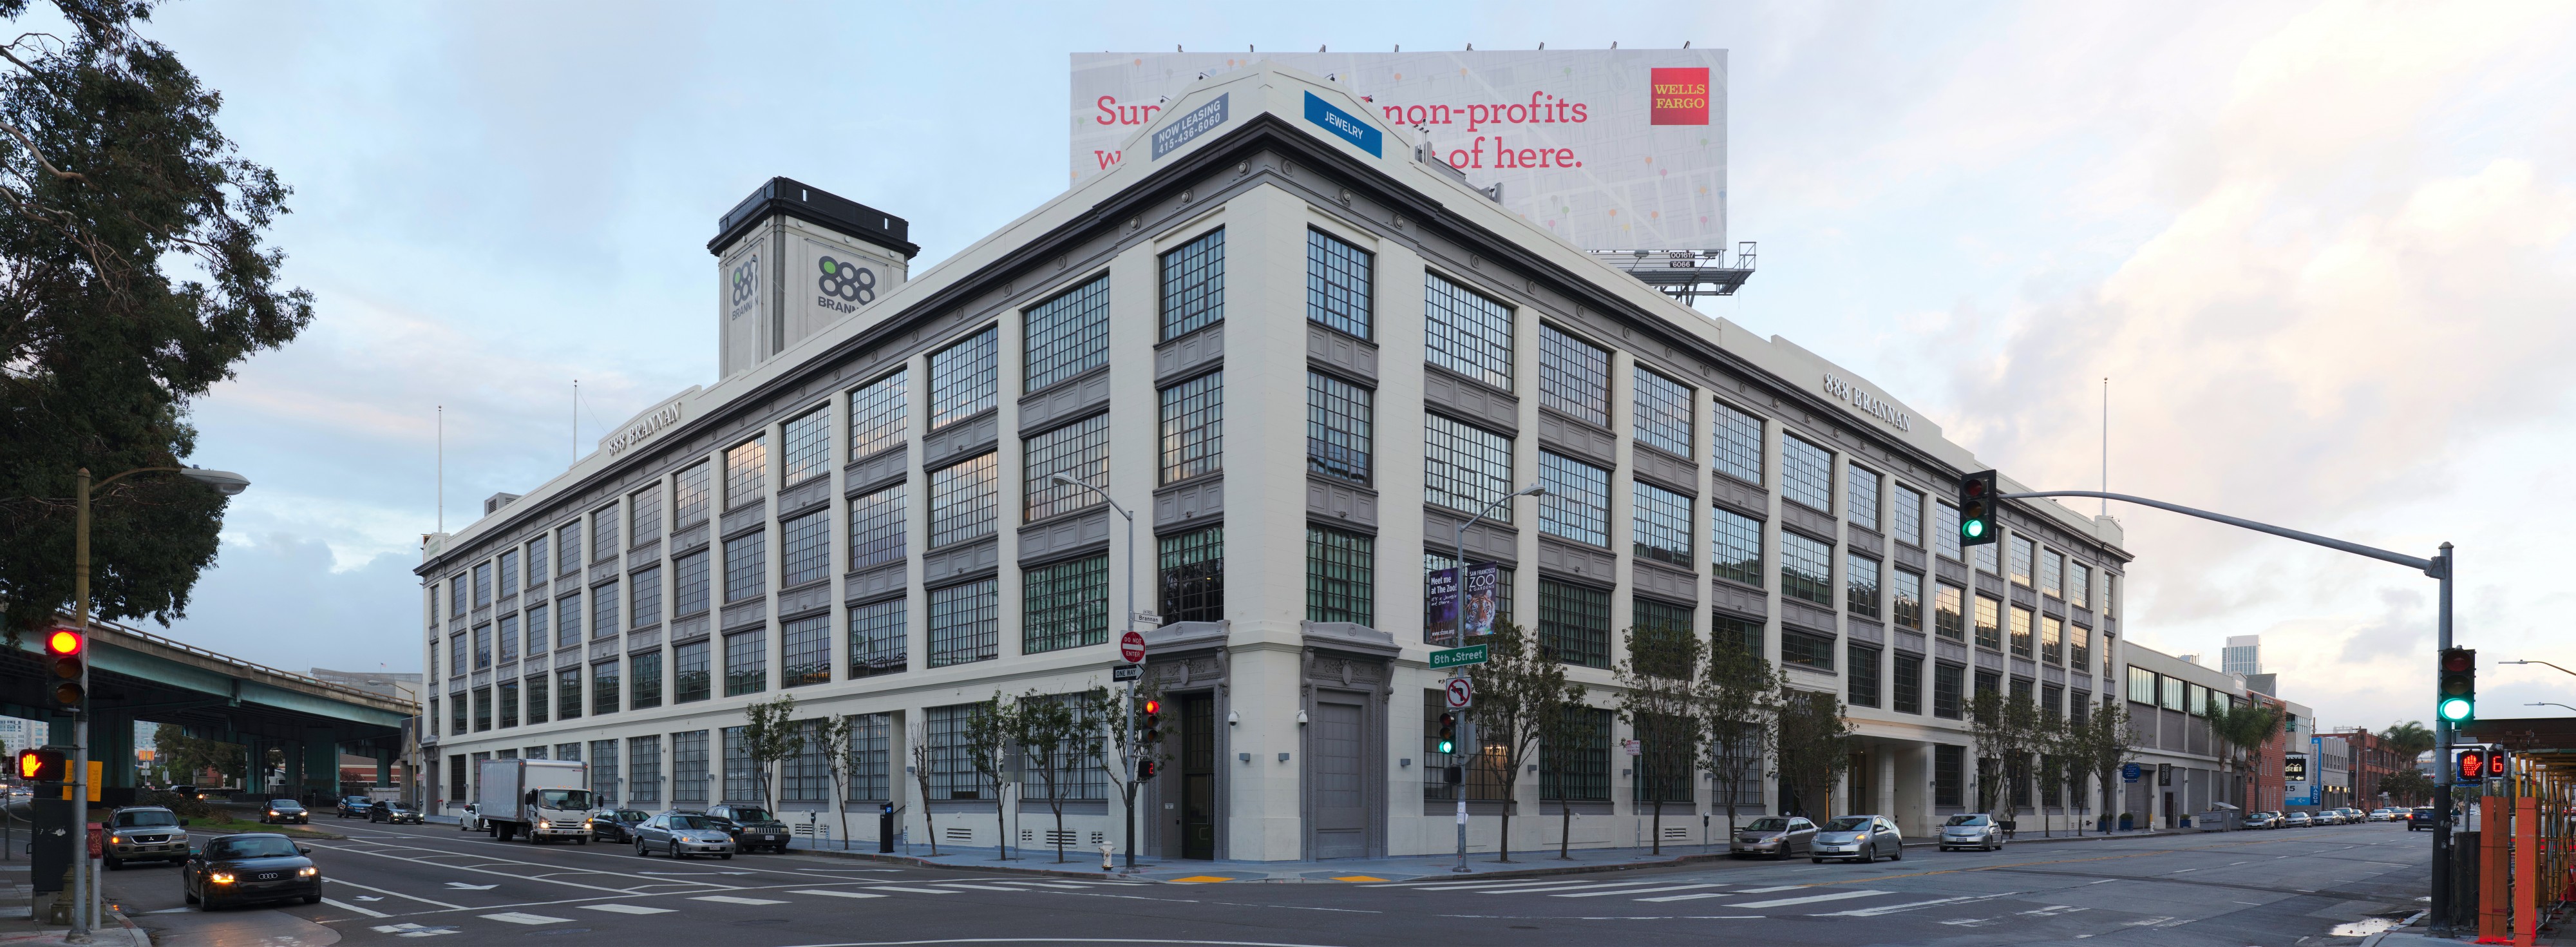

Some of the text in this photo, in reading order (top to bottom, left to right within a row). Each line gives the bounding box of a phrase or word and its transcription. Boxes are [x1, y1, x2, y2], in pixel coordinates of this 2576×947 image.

[1654, 84, 1706, 95] WELLS
[1383, 90, 1588, 132] non-profits
[1656, 98, 1705, 109] FARGO
[1159, 100, 1221, 142] NOW LEASING
[1324, 110, 1364, 140] JEWELRY
[1159, 112, 1221, 155] 415-436-6060
[1448, 136, 1486, 169] of
[1493, 136, 1583, 169] here.
[819, 255, 876, 306] 888
[1824, 373, 1911, 432] 888 BRANNAN
[608, 401, 681, 456] 888 BRANNAN
[1431, 576, 1443, 586] Meet
[1431, 586, 1436, 595] at
[1446, 583, 1457, 593] Zoo!
[1469, 573, 1495, 588] ZOO
[1432, 628, 1455, 636] www.sfzoo.org
[1434, 649, 1483, 664] 8th Street
[2492, 756, 2503, 772] 6
